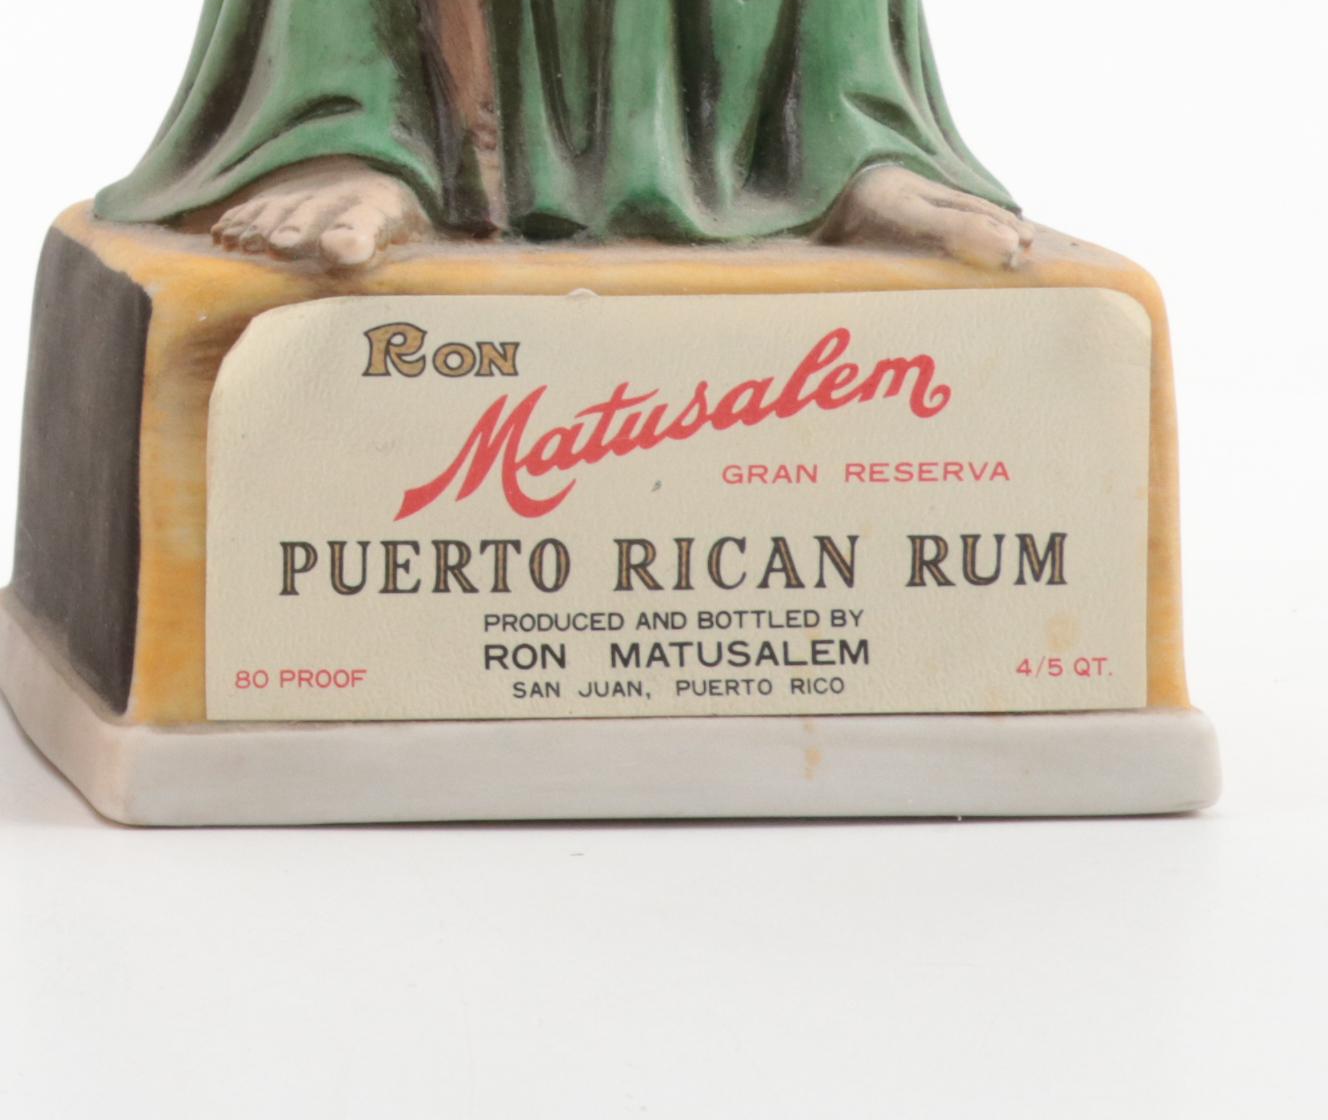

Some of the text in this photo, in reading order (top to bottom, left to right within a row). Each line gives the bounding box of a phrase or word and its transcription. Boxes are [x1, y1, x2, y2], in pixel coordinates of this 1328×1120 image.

[362, 322, 520, 378] RON
[393, 327, 952, 521] Matusalem
[722, 461, 1011, 484] GRAN RESERVA
[279, 532, 1069, 596] PUERTO RICAN RUM
[484, 609, 864, 633] PRODUCED AND BOTTLED BY
[484, 639, 870, 671] RON MATUSALEM
[1015, 656, 1114, 677] 4/5 QT.
[235, 668, 368, 690] 80 PROOF
[513, 676, 845, 701] SAN JUAN, PUERTO RICO
